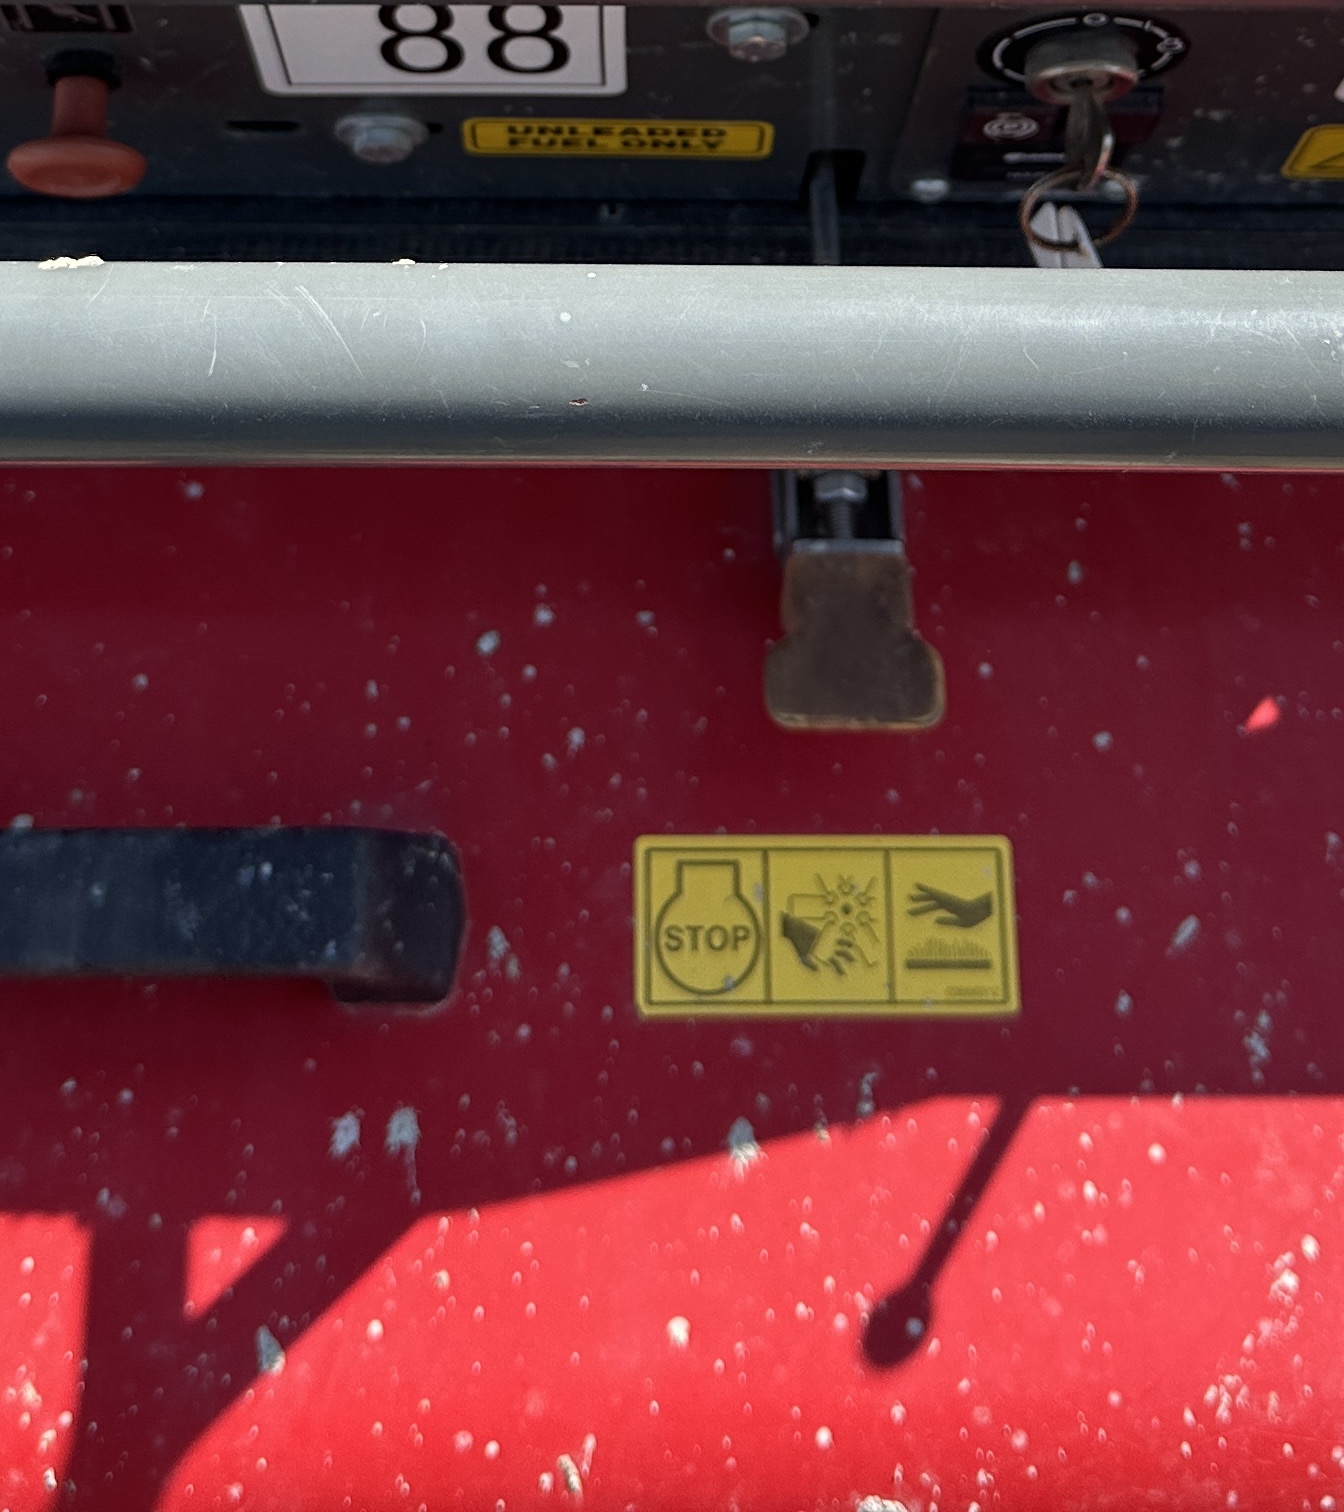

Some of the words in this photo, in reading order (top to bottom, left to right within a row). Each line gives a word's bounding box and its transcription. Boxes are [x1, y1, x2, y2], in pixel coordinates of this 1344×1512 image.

[378, 5, 570, 73] 88
[507, 125, 727, 137] UNLEADED
[508, 137, 598, 149] FUEL
[620, 138, 725, 150] ONLY
[665, 924, 751, 952] STOP
